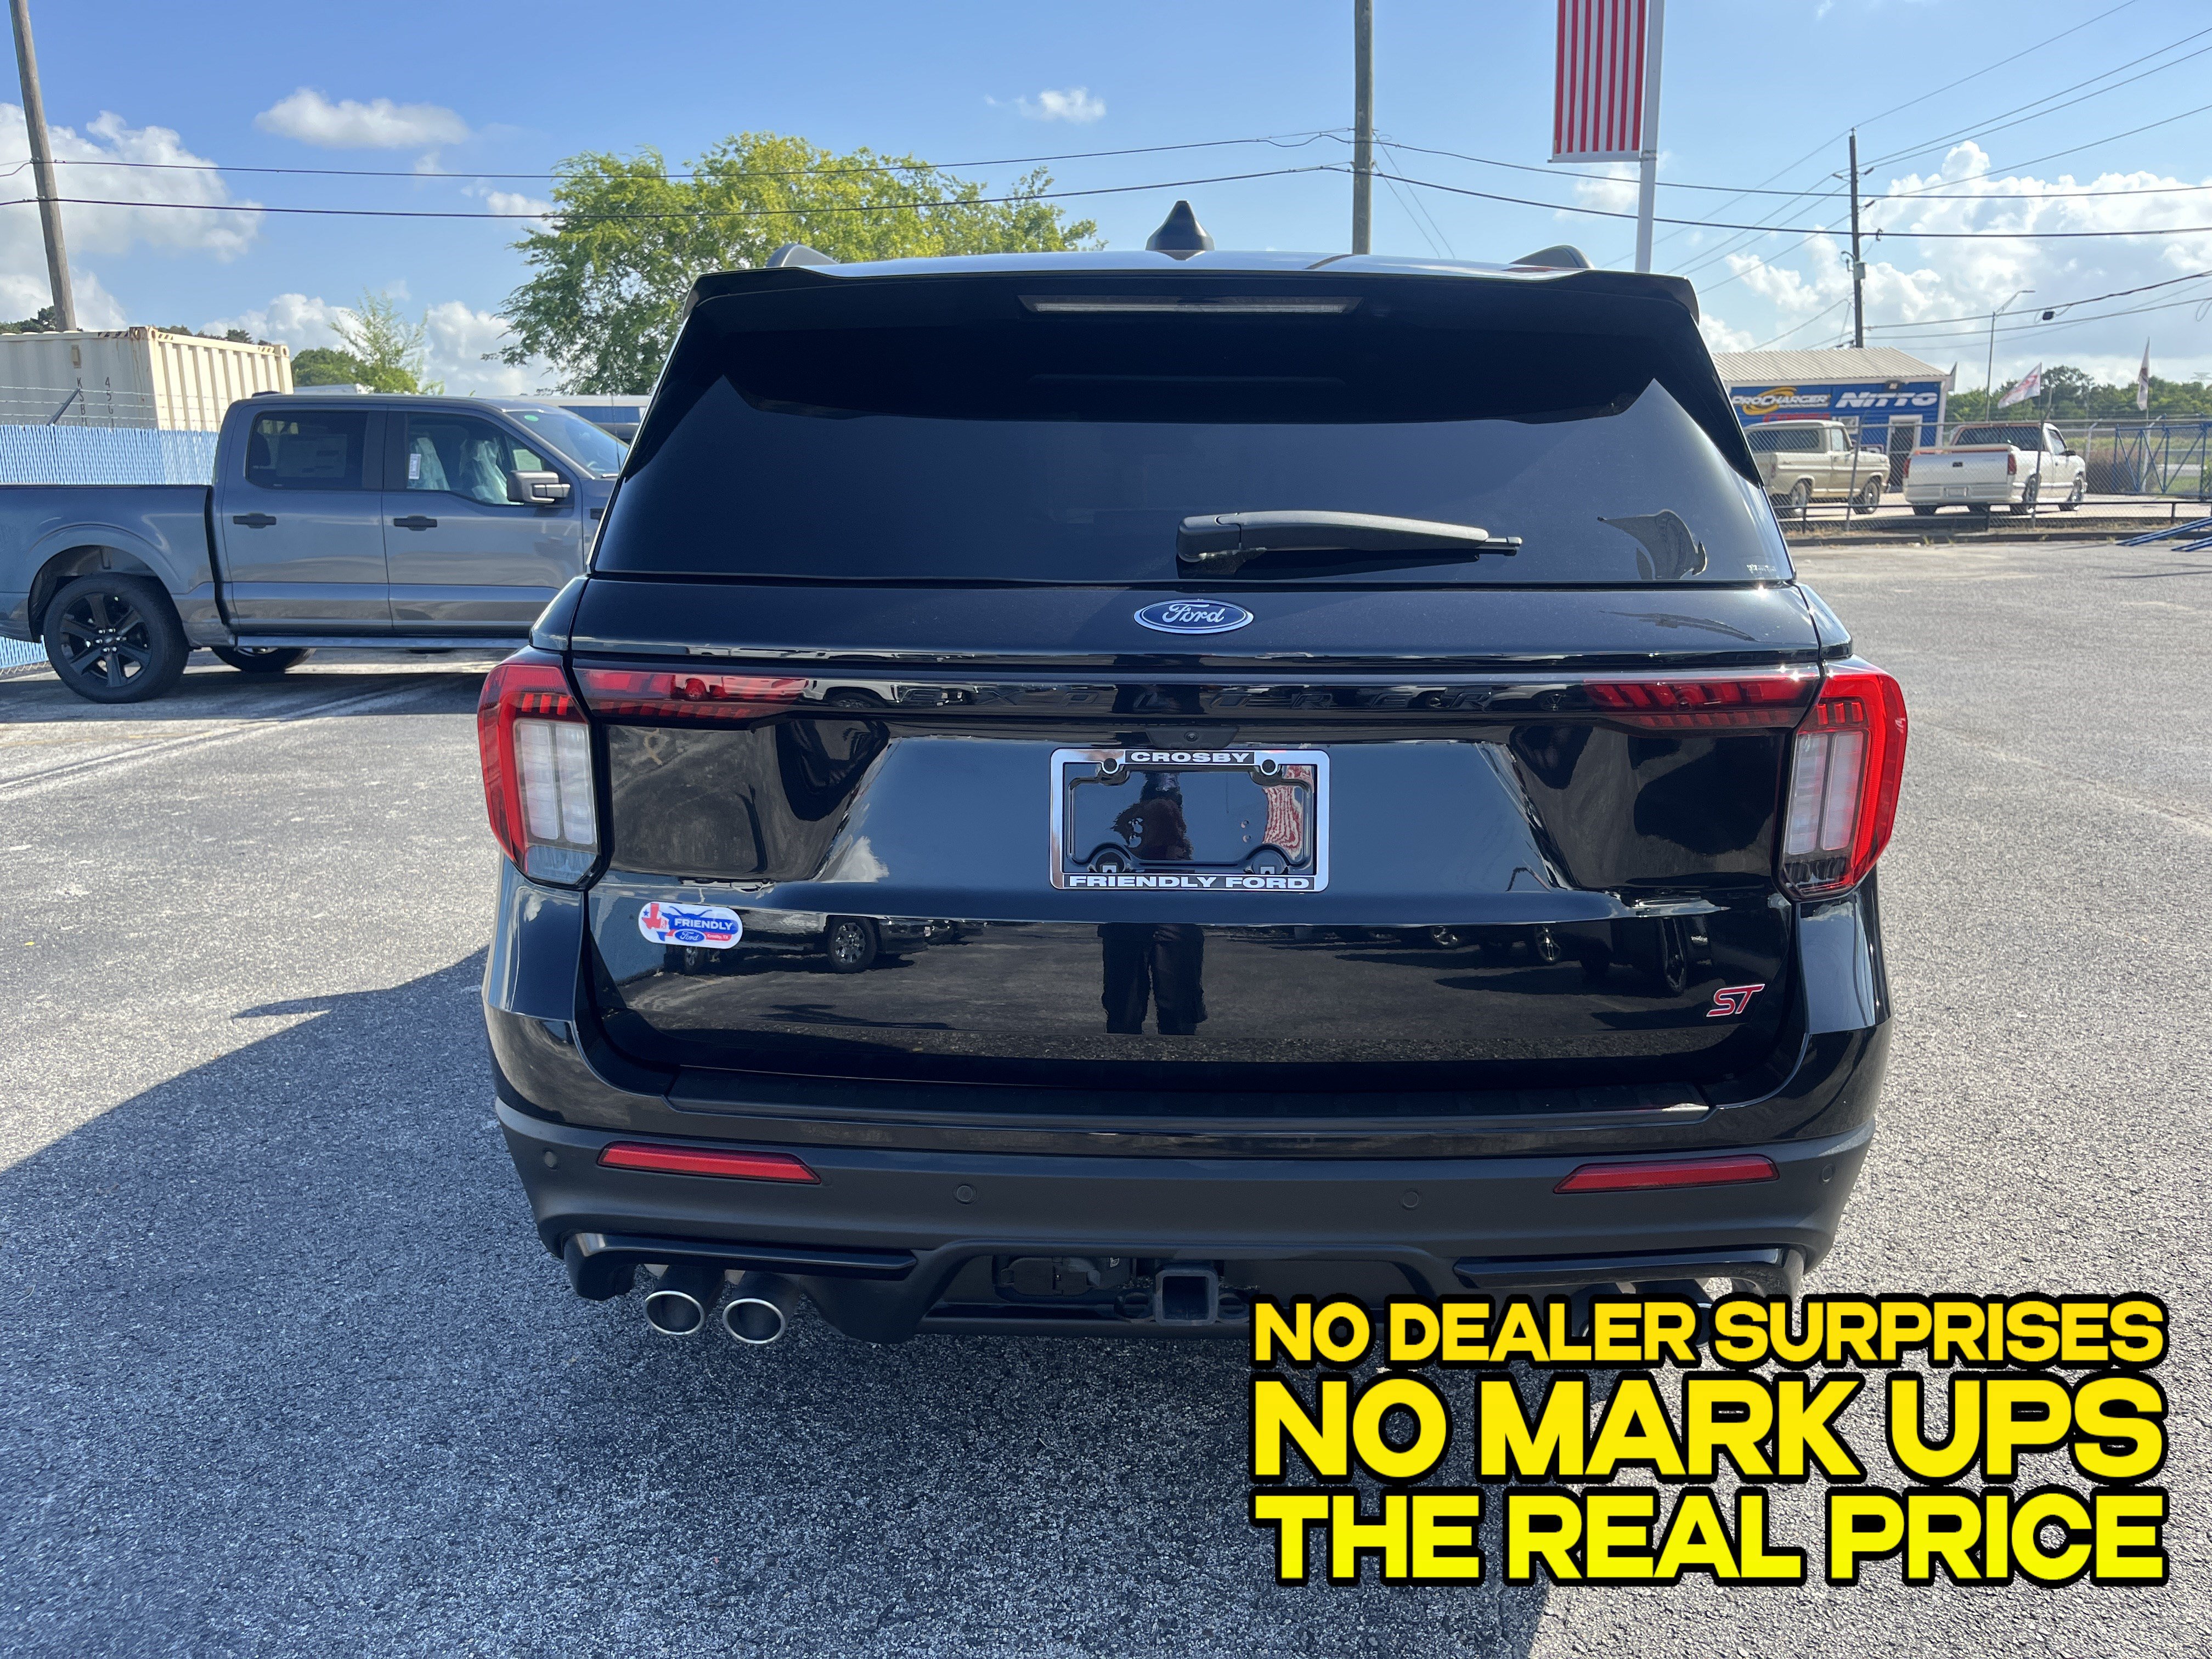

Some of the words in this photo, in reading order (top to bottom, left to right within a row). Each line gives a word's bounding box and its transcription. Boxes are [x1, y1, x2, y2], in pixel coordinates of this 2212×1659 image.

[1835, 392, 1938, 408] NITTO
[1162, 603, 1226, 623] Ford
[1130, 752, 1250, 763] CROSBY
[1069, 876, 1216, 888] FRIENDLY
[1225, 877, 1310, 889] FORD
[674, 918, 733, 931] FRIENDLY
[680, 931, 699, 941] Ford
[1706, 983, 1765, 1017] ST
